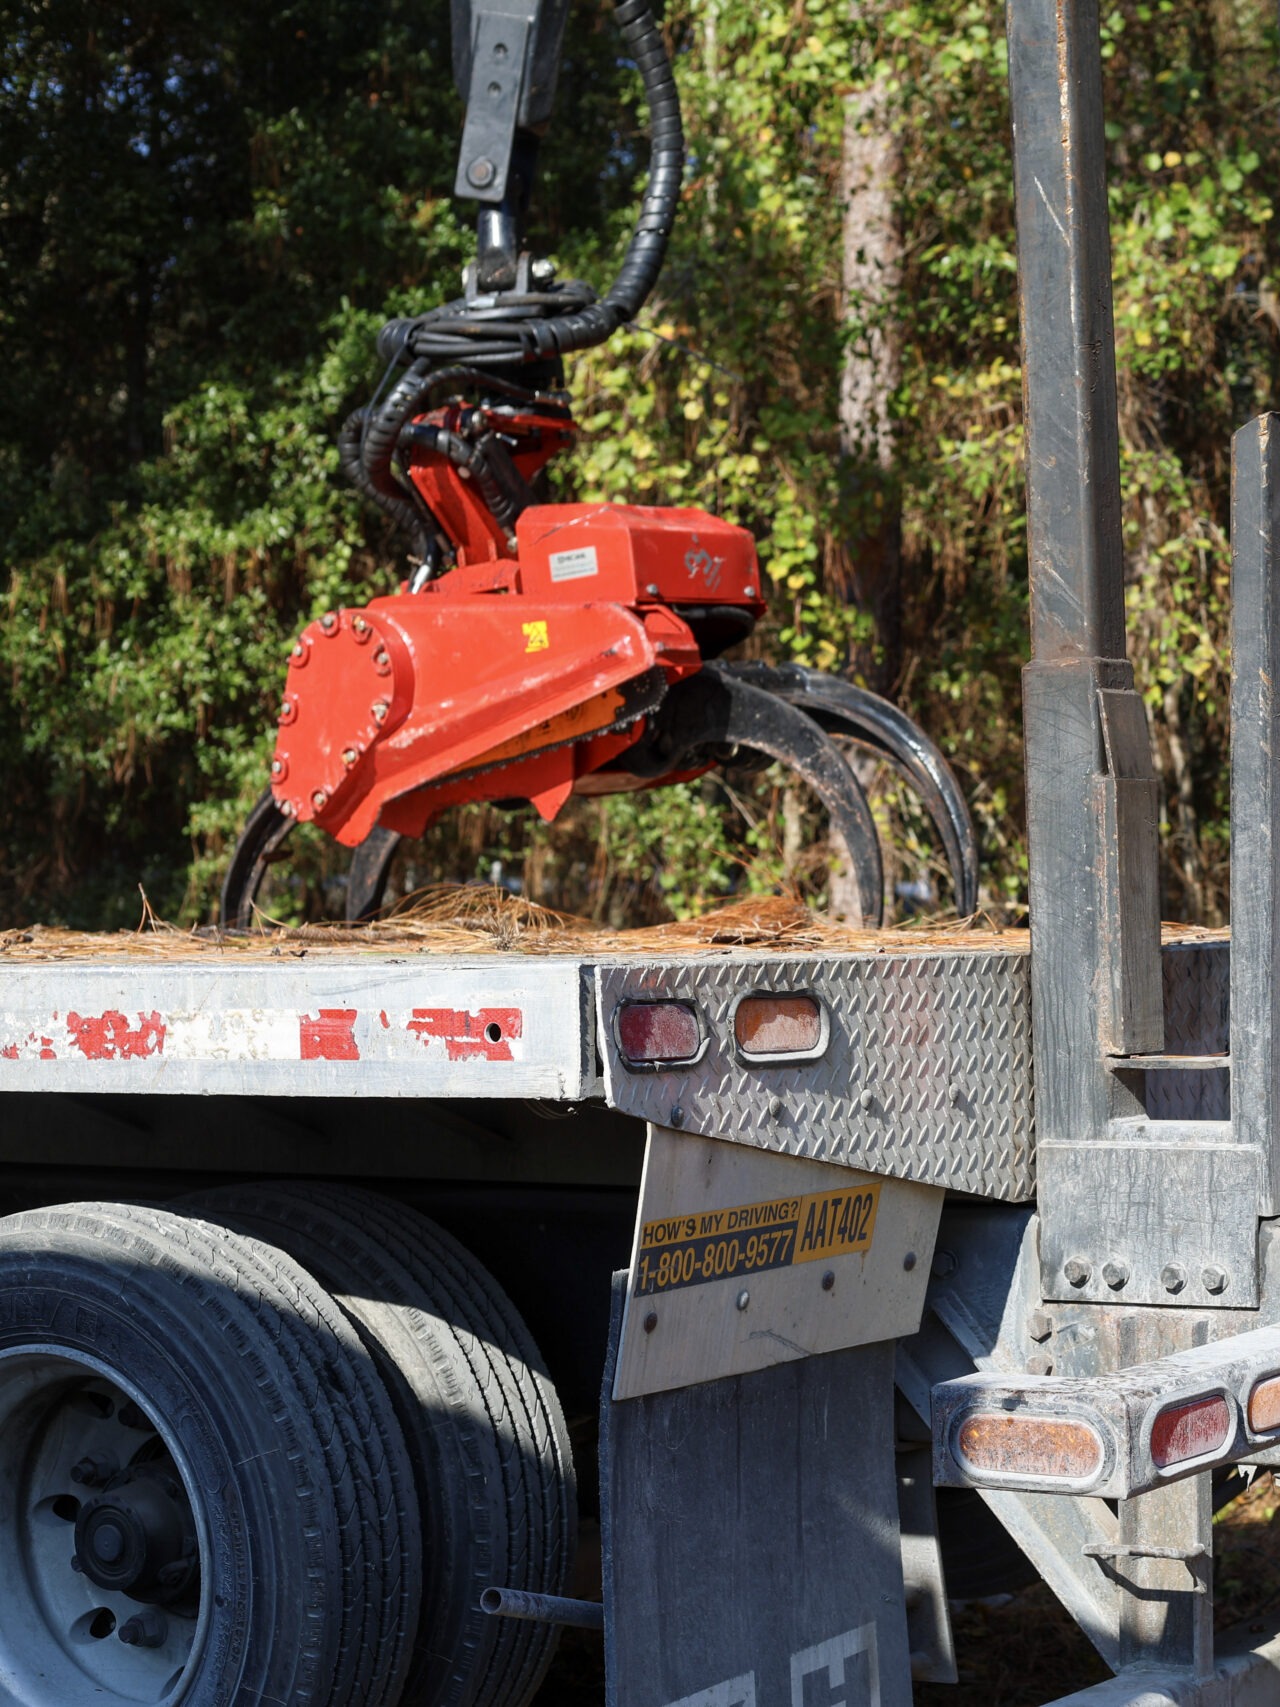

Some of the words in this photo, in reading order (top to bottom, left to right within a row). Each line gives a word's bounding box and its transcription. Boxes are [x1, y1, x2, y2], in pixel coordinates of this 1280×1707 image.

[642, 1220, 696, 1245] HOW'S
[699, 1213, 724, 1235] MY
[727, 1200, 798, 1229] DRIVING?
[801, 1194, 873, 1251] AAT402
[640, 1228, 795, 1290] 1-800-800-9577
